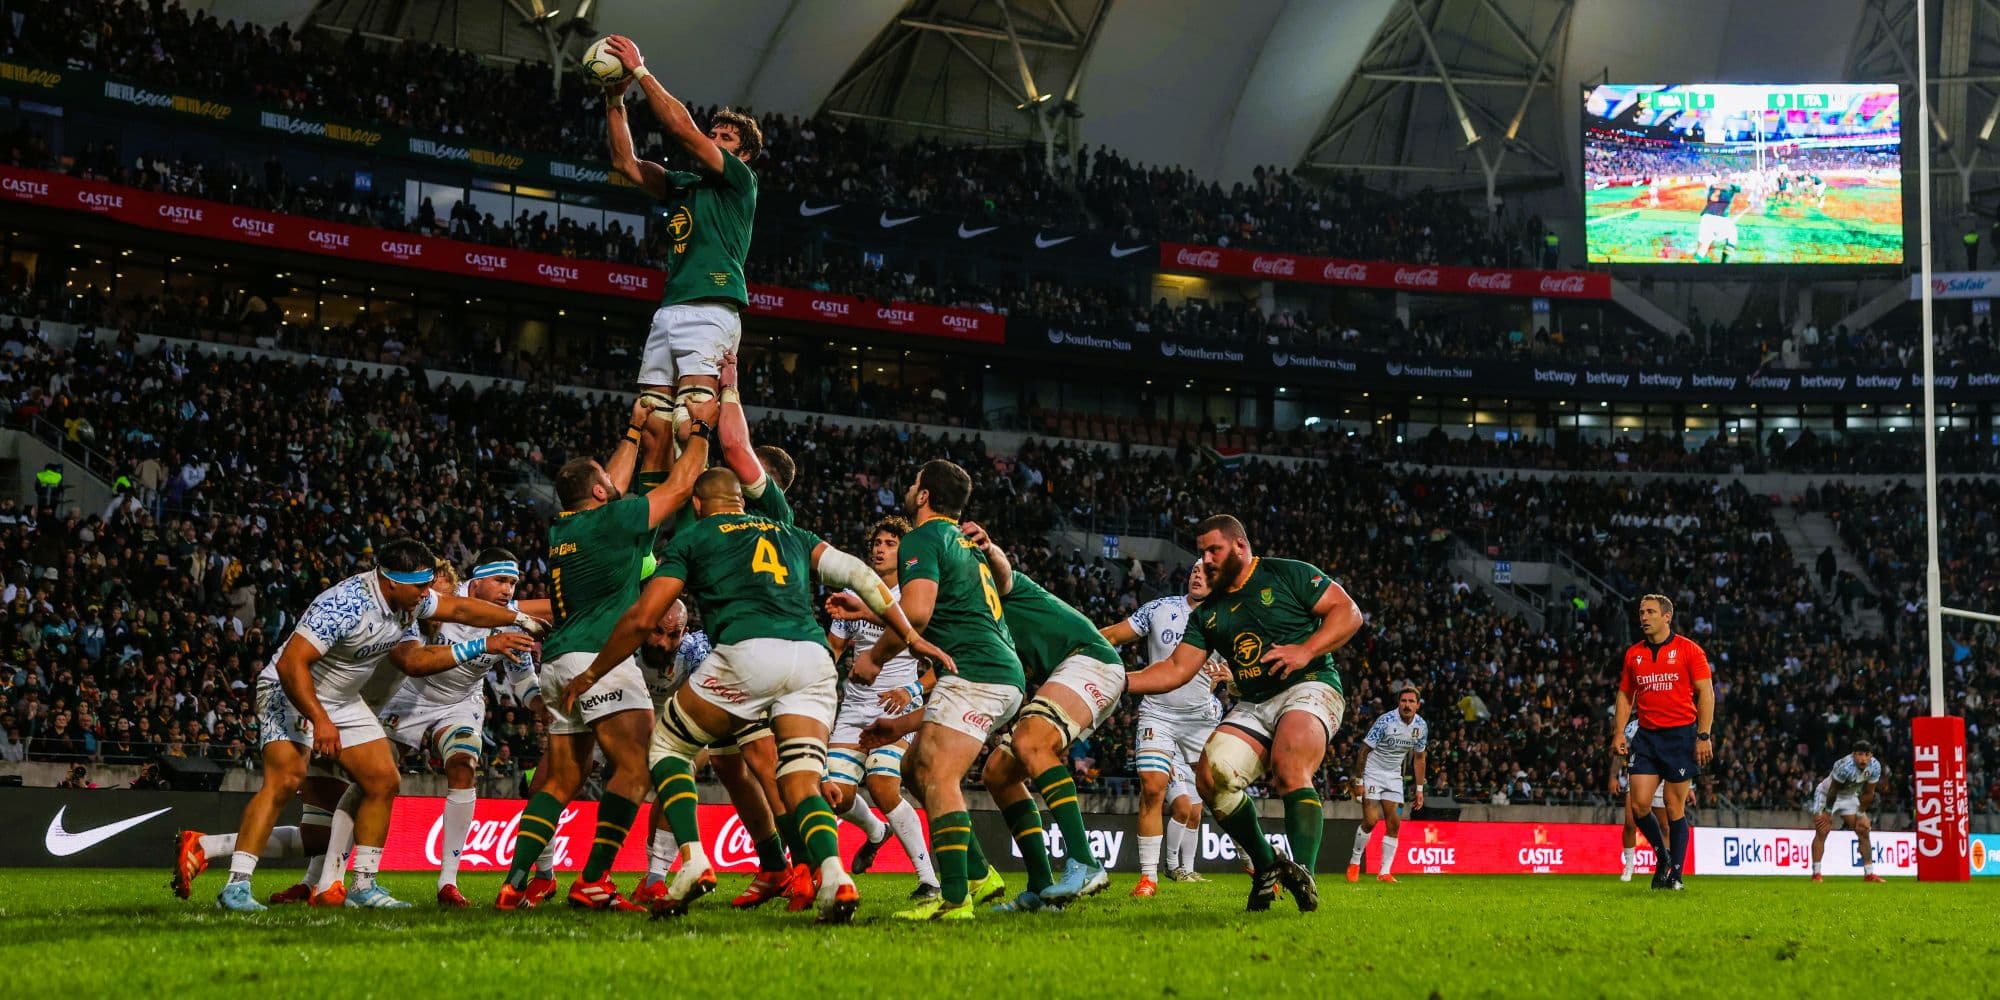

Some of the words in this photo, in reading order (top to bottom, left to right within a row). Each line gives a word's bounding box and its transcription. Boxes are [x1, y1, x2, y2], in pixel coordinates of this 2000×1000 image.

[2, 177, 49, 196] CASTLE
[78, 191, 124, 208] CASTLE
[159, 204, 204, 222] CASTLE
[232, 216, 275, 235] CASTLE
[308, 230, 349, 247] CASTLE
[381, 241, 422, 256] CASTLE
[465, 253, 507, 269] CASTLE
[538, 264, 578, 280] CASTLE
[608, 272, 648, 289] CASTLE
[811, 300, 850, 315] CASTLE
[877, 308, 915, 322] CASTLE
[942, 315, 979, 330] CASTLE
[1534, 368, 1577, 384] betway
[1586, 370, 1629, 386] betway
[1639, 372, 1682, 388] betway
[1692, 373, 1737, 389] betway
[1801, 374, 1846, 391] betway
[1856, 374, 1902, 390] betway
[752, 536, 788, 585] 4
[979, 563, 1003, 621] 6
[1239, 666, 1261, 680] FNB
[1636, 672, 1679, 685] Emirates
[1915, 745, 1943, 857] CASTLE
[1944, 780, 1954, 821] LAGER
[1955, 745, 1967, 857] CASTLE
[1408, 848, 1456, 865] CASTLE
[1518, 848, 1563, 865] CASTLE
[1724, 837, 1761, 866] Pick
[1764, 844, 1772, 862] n
[1776, 838, 1809, 869] Pay
[1887, 847, 1894, 863] n
